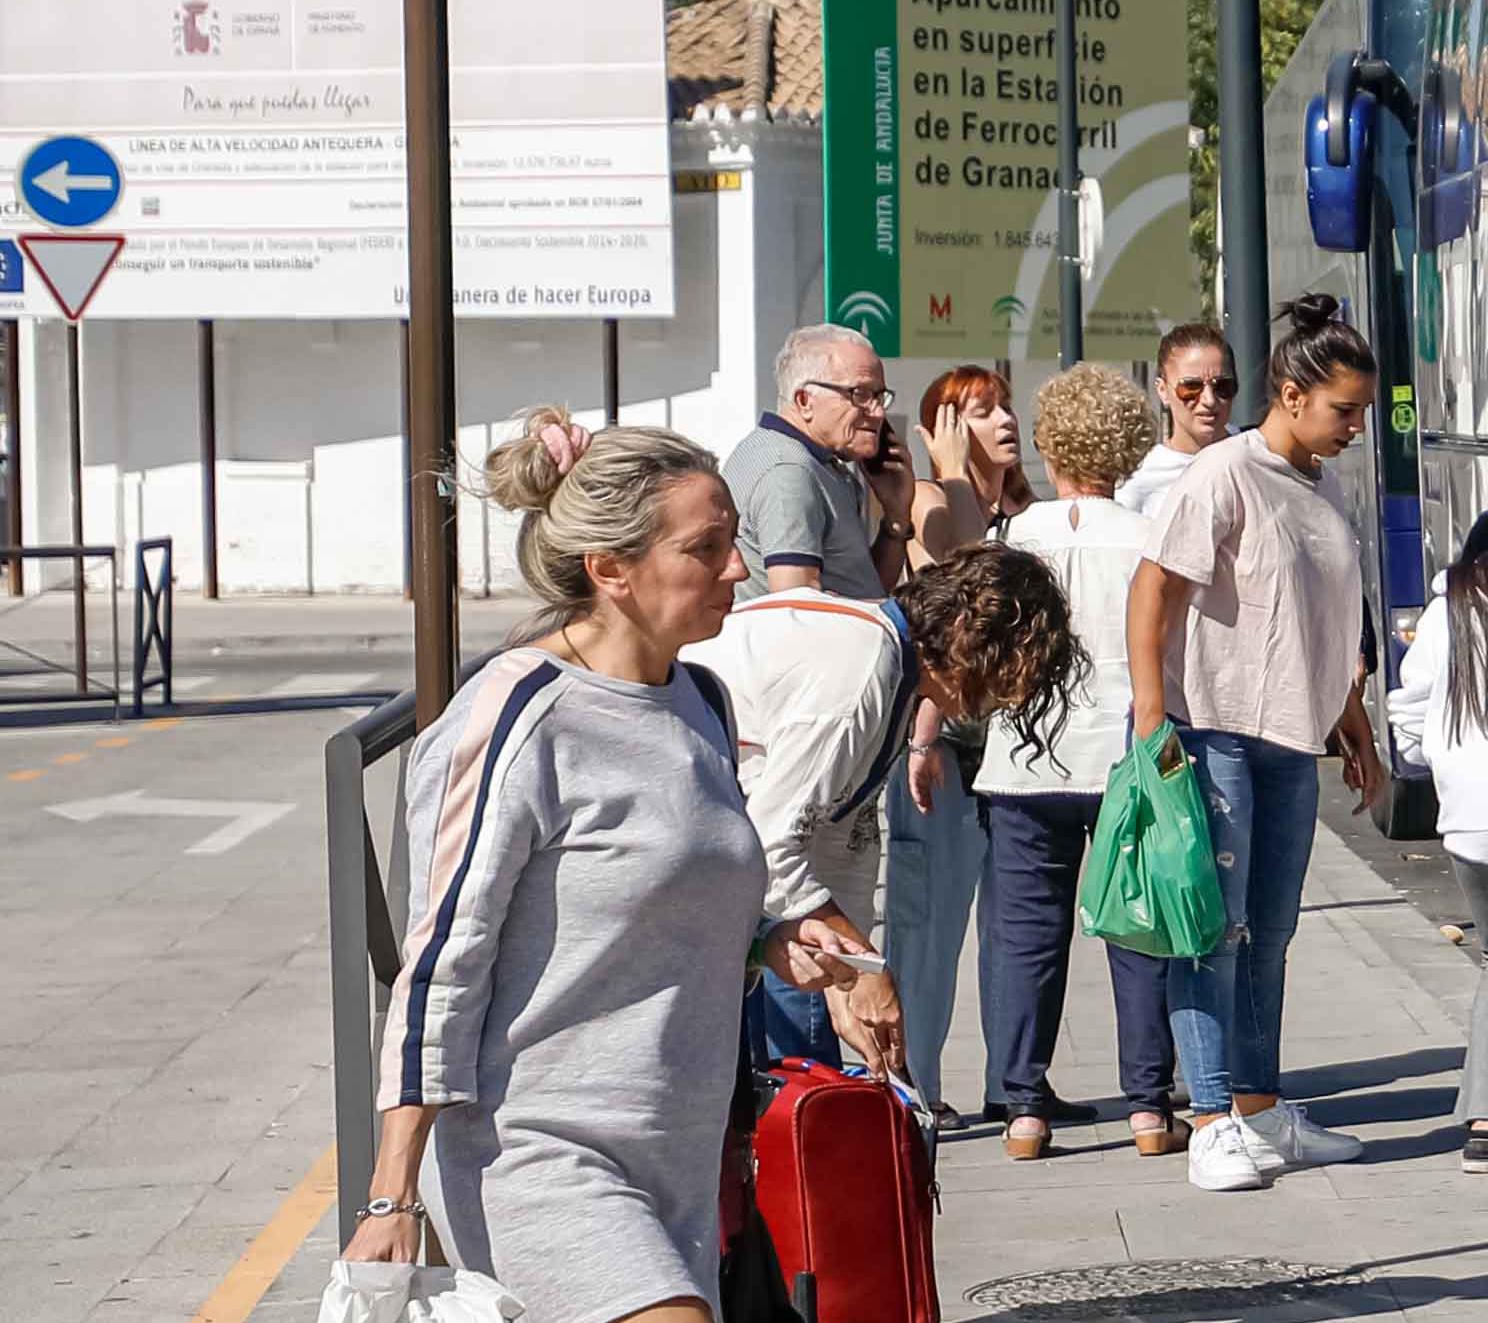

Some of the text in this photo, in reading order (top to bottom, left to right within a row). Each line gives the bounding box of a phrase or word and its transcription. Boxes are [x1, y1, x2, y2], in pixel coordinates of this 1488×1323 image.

[913, 29, 1106, 62] en superfie
[183, 85, 371, 117] Para que puedas llegar
[913, 68, 1123, 107] en la Estaión
[169, 137, 187, 151] DE
[190, 137, 222, 151] ALTA
[224, 136, 299, 151] VELOCIDAD
[302, 135, 384, 150] ANTEQUERA
[914, 110, 1118, 149] de Ferrocrril
[876, 161, 892, 185] DE
[914, 157, 1062, 190] de Grana
[876, 193, 893, 254] JUNTA
[451, 285, 652, 308] anera de hacer Europa
